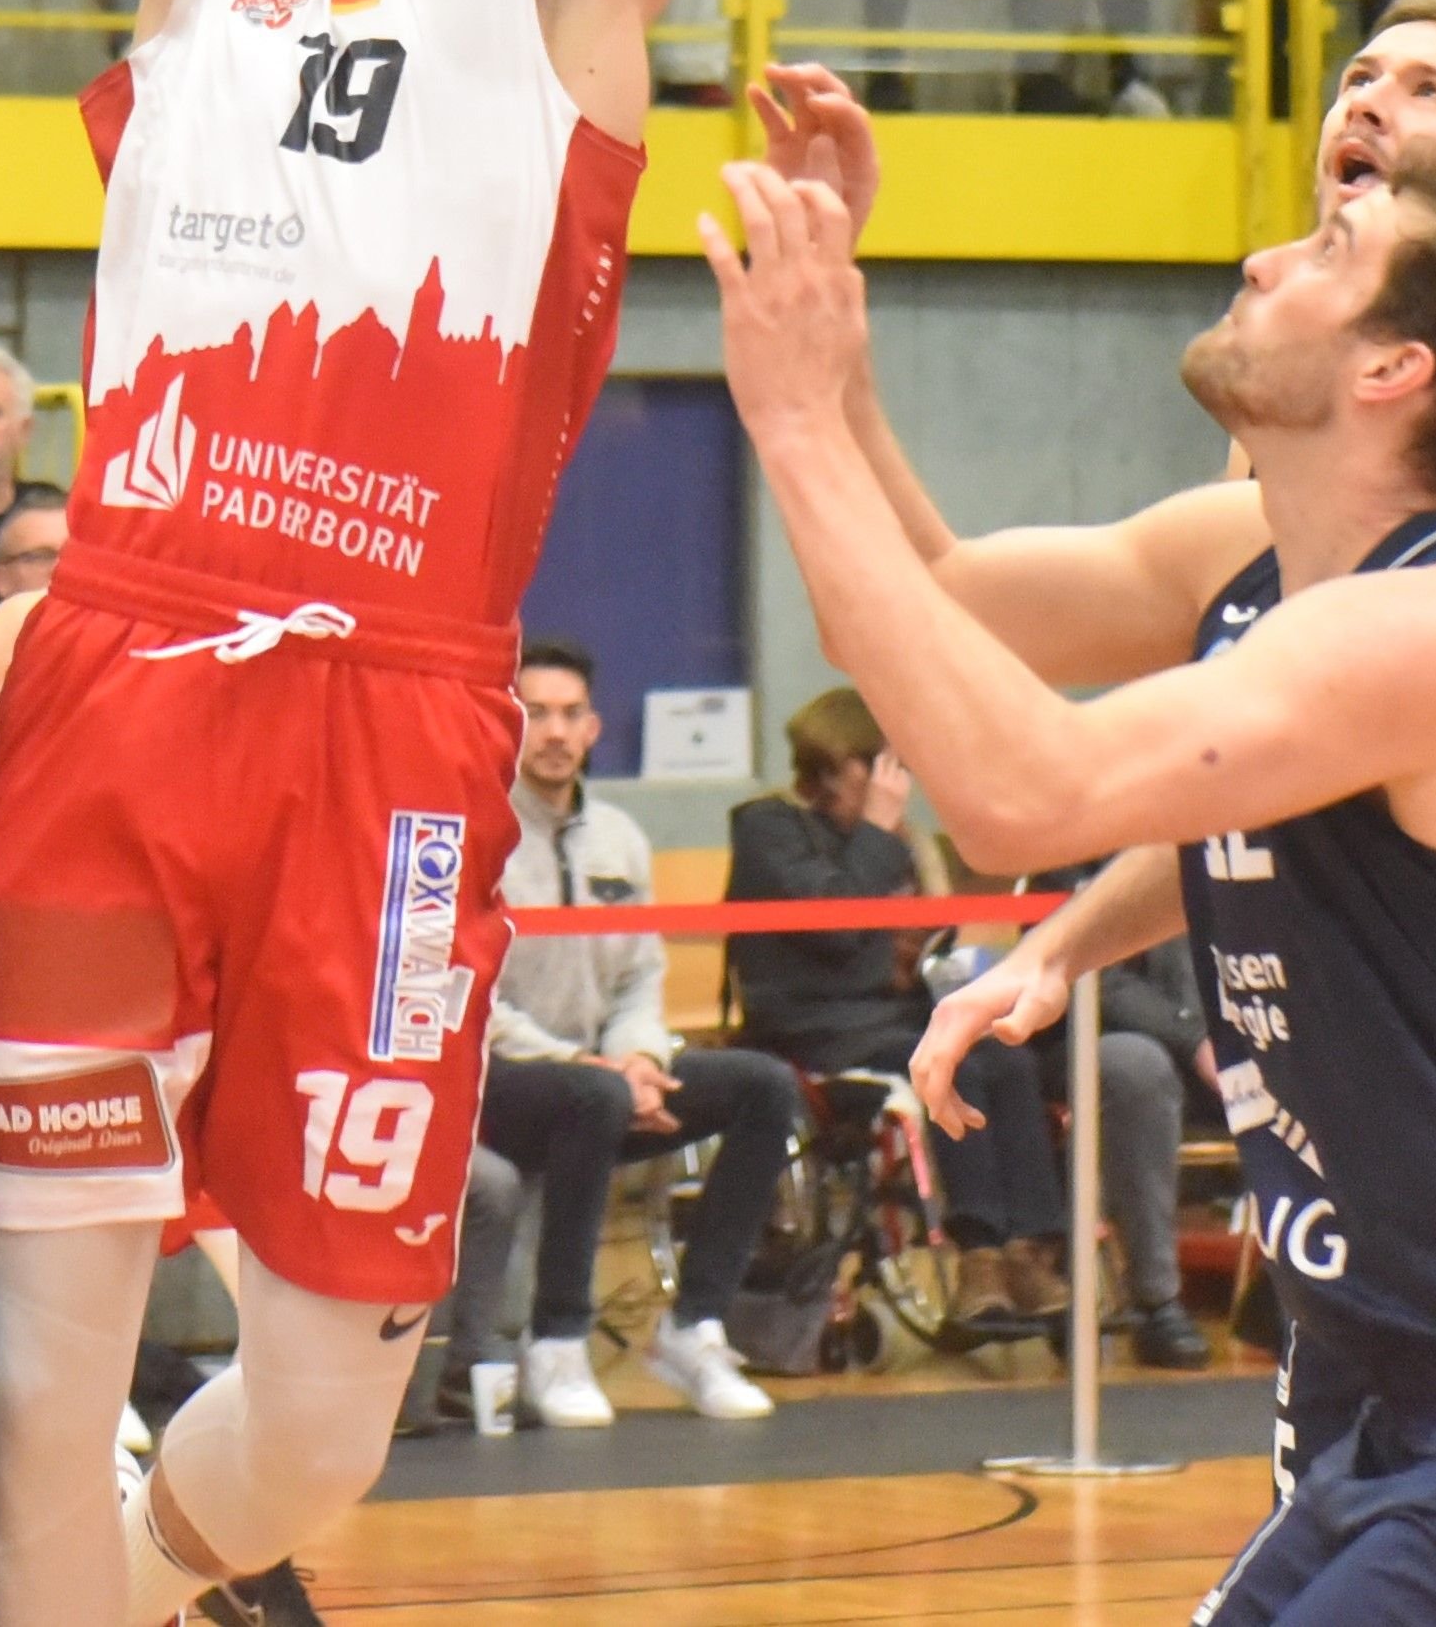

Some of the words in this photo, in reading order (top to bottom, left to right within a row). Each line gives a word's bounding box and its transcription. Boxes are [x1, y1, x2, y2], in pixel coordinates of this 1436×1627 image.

[279, 31, 407, 165] 19
[202, 480, 424, 579] PADERBORN
[208, 431, 441, 529] UNIVERSITÄT
[38, 1095, 142, 1134] HOUSE
[295, 1069, 435, 1212] 19
